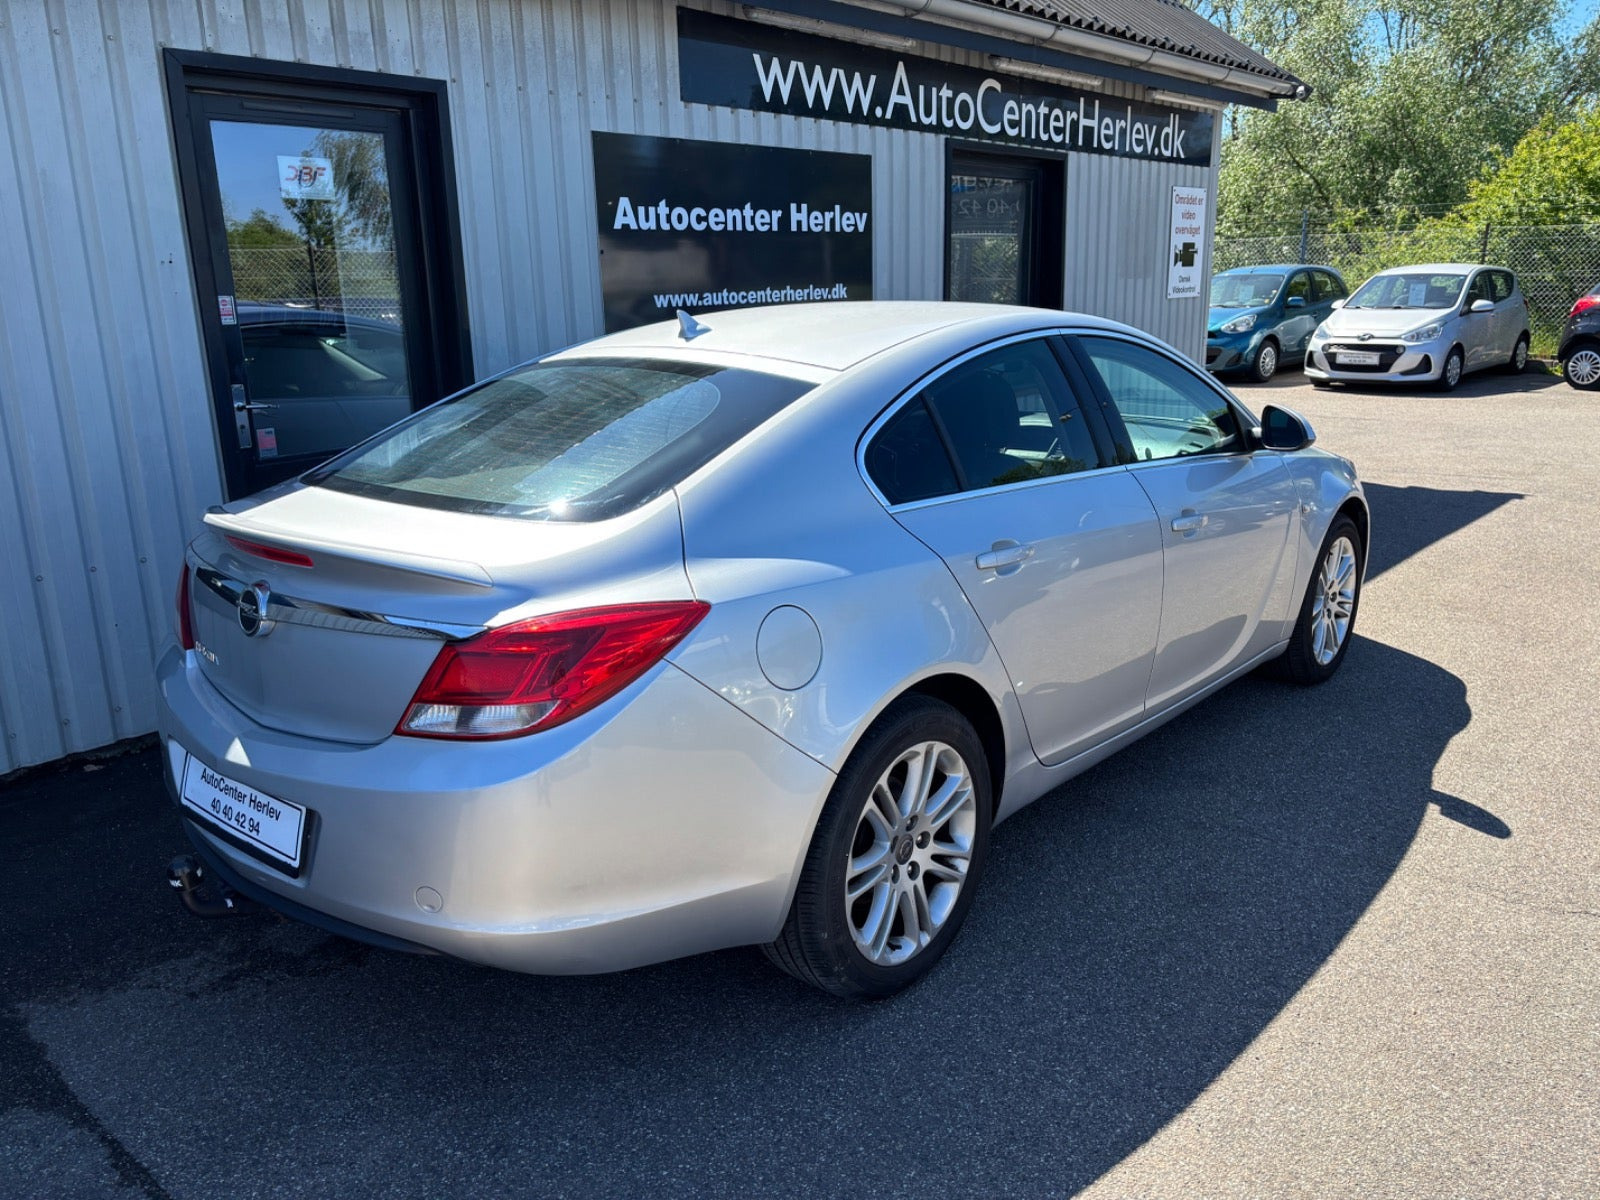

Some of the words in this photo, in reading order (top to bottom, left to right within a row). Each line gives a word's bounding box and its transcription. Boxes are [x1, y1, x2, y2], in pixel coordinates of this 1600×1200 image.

[613, 196, 783, 232] Autocenter
[790, 203, 868, 233] Herlev
[1182, 210, 1196, 220] video
[653, 283, 848, 308] www.autocenterherlev.dk
[201, 767, 247, 805] AutoCenter
[249, 793, 281, 822] Herlev
[211, 798, 221, 814] 40
[222, 805, 233, 821] 40
[235, 811, 247, 829] 42
[248, 817, 260, 837] 94
